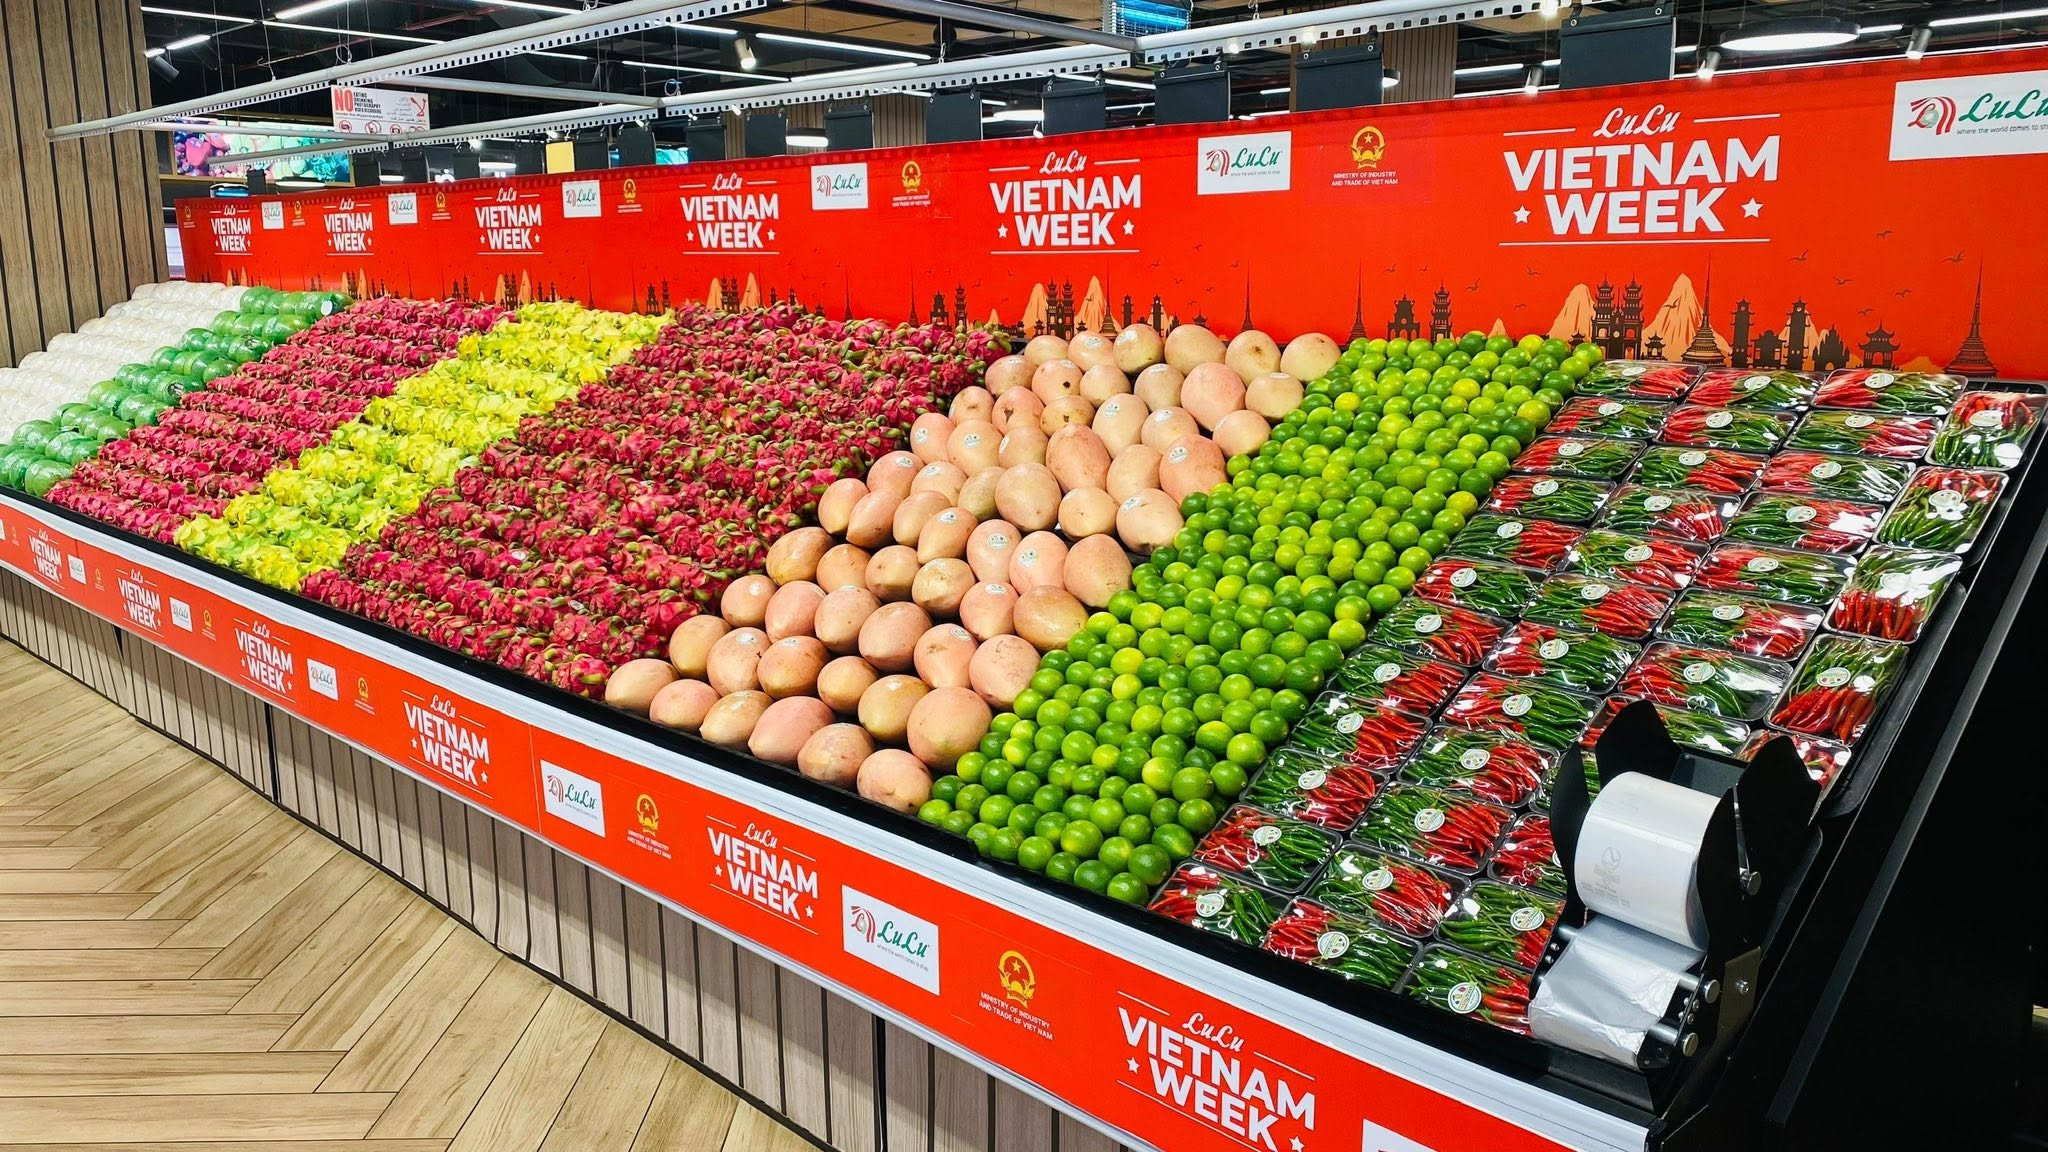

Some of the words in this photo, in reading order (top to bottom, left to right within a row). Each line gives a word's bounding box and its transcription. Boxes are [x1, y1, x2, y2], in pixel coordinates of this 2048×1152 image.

[334, 88, 354, 112] NO
[1593, 104, 1681, 138] LuLu
[1039, 150, 1087, 174] LuLu
[1231, 146, 1280, 169] LuLu
[1504, 135, 1781, 192] VIETNAM
[496, 187, 516, 202] LuLu
[712, 173, 742, 192] LuLu
[832, 172, 862, 190] LuLu
[989, 174, 1141, 214] VIETNAM
[324, 212, 373, 233] VIETNAM
[474, 204, 542, 228] VIETNAM
[680, 193, 779, 222] VIETNAM
[1544, 187, 1728, 235] WEEK
[211, 218, 251, 235] VIETNAM
[333, 232, 366, 252] WEEK
[488, 228, 532, 250] WEEK
[697, 222, 763, 249] WEEK
[1015, 212, 1115, 247] WEEK
[218, 235, 246, 251] WEEK
[29, 535, 62, 567] VIETNAM
[37, 556, 60, 583] WEEK
[118, 577, 161, 613] VIETNAM
[127, 600, 157, 630] WEEK
[234, 628, 293, 675] VIETNAM
[247, 656, 286, 694] WEEK
[429, 694, 456, 719] LuLu
[403, 702, 490, 765] VIETNAM
[420, 735, 478, 786] WEEK
[565, 783, 597, 810] LuLu
[743, 822, 778, 849] LuLu
[707, 826, 818, 899] VIETNAM
[727, 862, 800, 921] WEEK
[877, 920, 927, 958] LuLu
[979, 1000, 992, 1011] AND
[992, 1006, 1012, 1022] TRADE
[1022, 1020, 1037, 1032] VIET
[1037, 1027, 1053, 1040] NAM
[981, 992, 1008, 1010] MINISTRY
[1010, 1005, 1018, 1014] OF
[1019, 1010, 1050, 1028] INDUSTRY
[1182, 1012, 1244, 1052] LuLu
[1118, 1006, 1316, 1130] VIETNAM
[1149, 1057, 1280, 1152] WEEK
